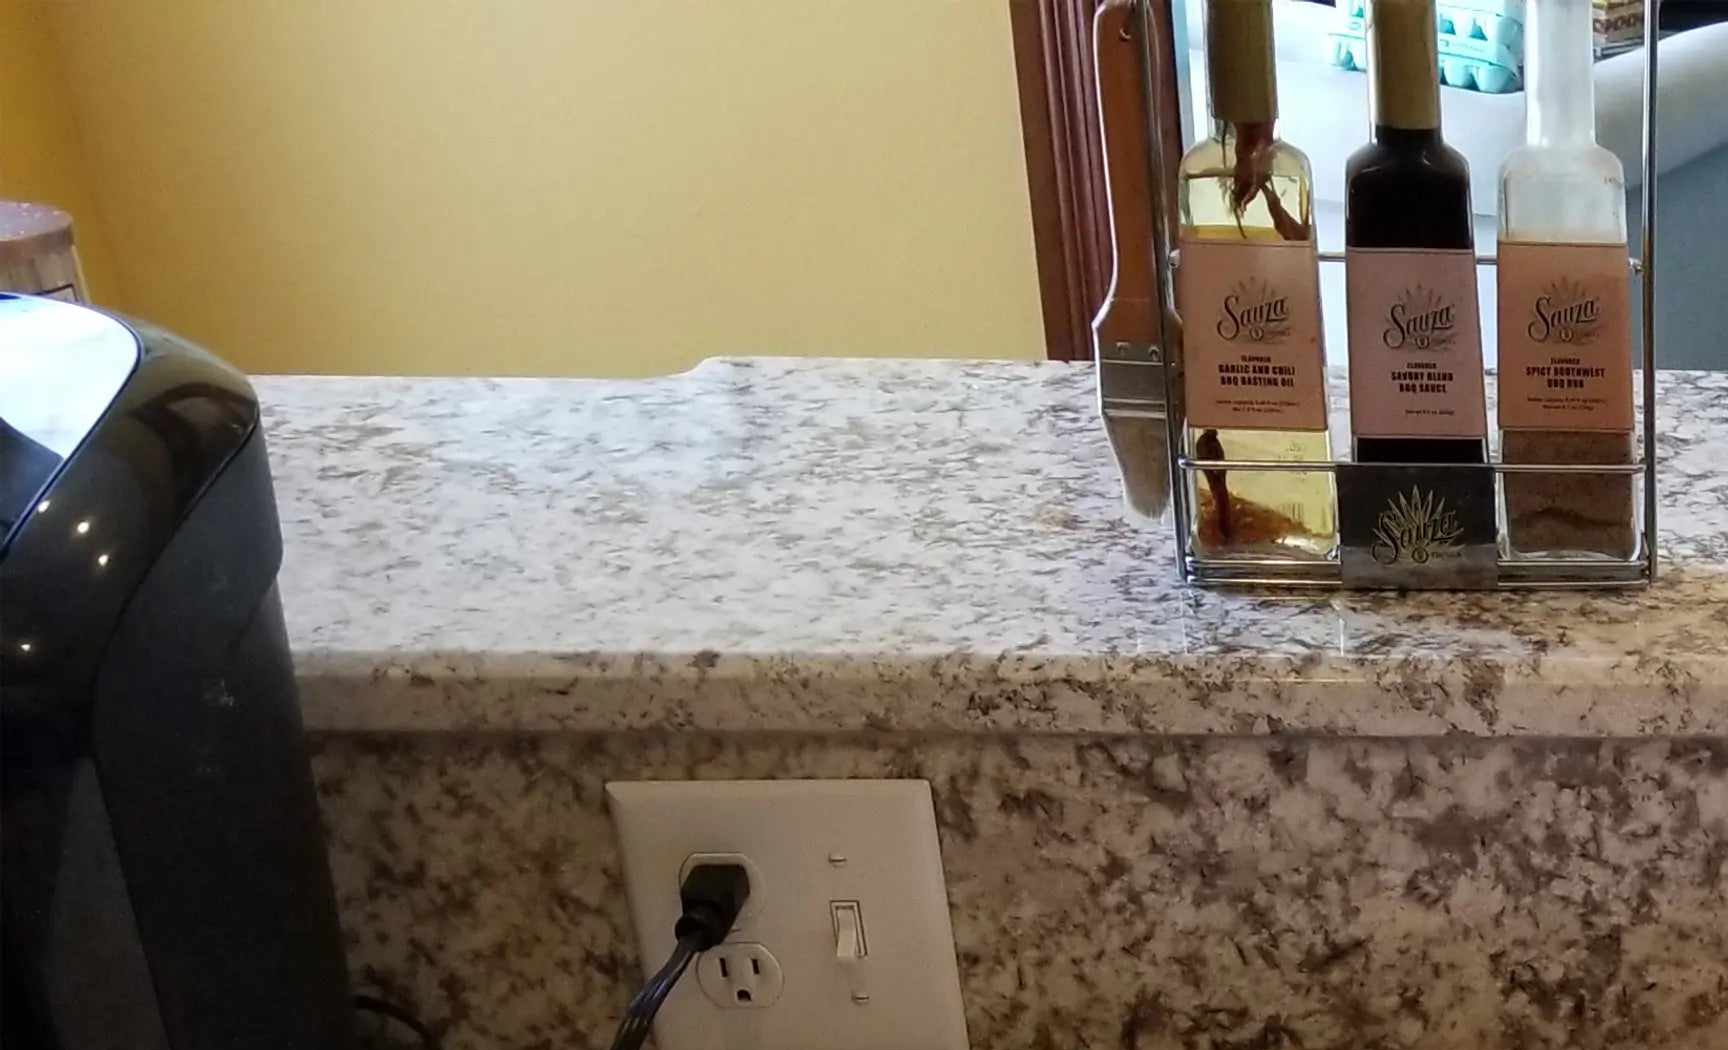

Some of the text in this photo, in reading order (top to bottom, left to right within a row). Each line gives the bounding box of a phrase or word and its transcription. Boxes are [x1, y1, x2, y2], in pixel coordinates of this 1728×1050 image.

[1217, 295, 1289, 340] Sauza
[1528, 296, 1600, 343] Sauza
[1383, 303, 1455, 349] Sauza
[1218, 364, 1295, 376] GARLIC AND CHILI
[1391, 371, 1454, 381] SAVORY BLEND
[1526, 366, 1606, 377] SPICY SOUTHWEST
[1220, 376, 1294, 387] BBQ BASTING OIL
[1399, 383, 1447, 393] BBQ SAUCE
[1371, 509, 1464, 565] Sauza
